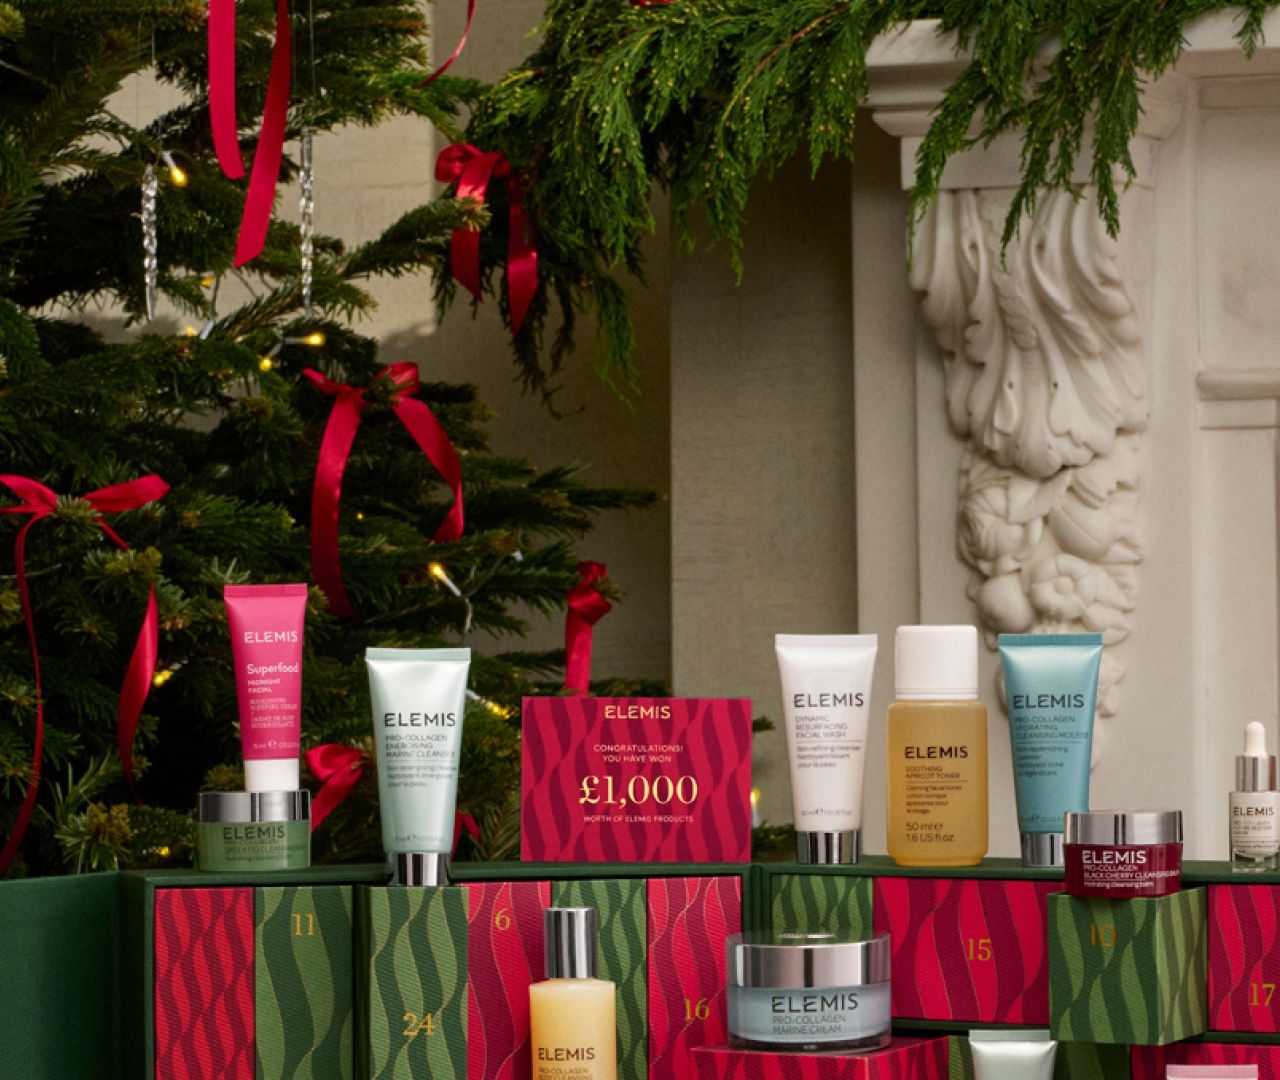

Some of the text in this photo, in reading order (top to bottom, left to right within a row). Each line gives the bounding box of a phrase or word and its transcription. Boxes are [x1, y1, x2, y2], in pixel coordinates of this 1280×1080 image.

[244, 631, 298, 643] ELEMIS
[246, 662, 299, 677] Superfood
[793, 693, 864, 707] ELEMIS
[1013, 694, 1085, 709] ELEMIS
[604, 705, 671, 719] ELEMIS
[384, 712, 456, 727] ELEMIS
[385, 734, 448, 742] PRO-COLLAGEN
[593, 744, 684, 753] CONGRATULATIONS!
[905, 746, 969, 759] ELEMIS
[603, 755, 671, 763] YOU HAVE WON
[579, 775, 698, 809] £1,000
[1233, 807, 1274, 816] ELEMIS
[613, 815, 623, 823] OF
[625, 815, 651, 823] ELEMIS
[653, 815, 694, 823] PRODUCTS
[223, 826, 286, 840] ELEMIS
[1082, 850, 1147, 864] ELEMIS
[291, 912, 315, 936] 11
[495, 908, 511, 931] 6
[1090, 922, 1117, 947] 10
[968, 938, 993, 961] 15
[1250, 983, 1275, 1006] 17
[684, 997, 710, 1021] 16
[771, 993, 859, 1013] ELEMIS
[402, 1011, 436, 1036] 24
[773, 1015, 846, 1024] PRO-COLLAGEN
[773, 1025, 842, 1035] MARINE CREAM
[538, 1047, 595, 1061] ELEMIS
